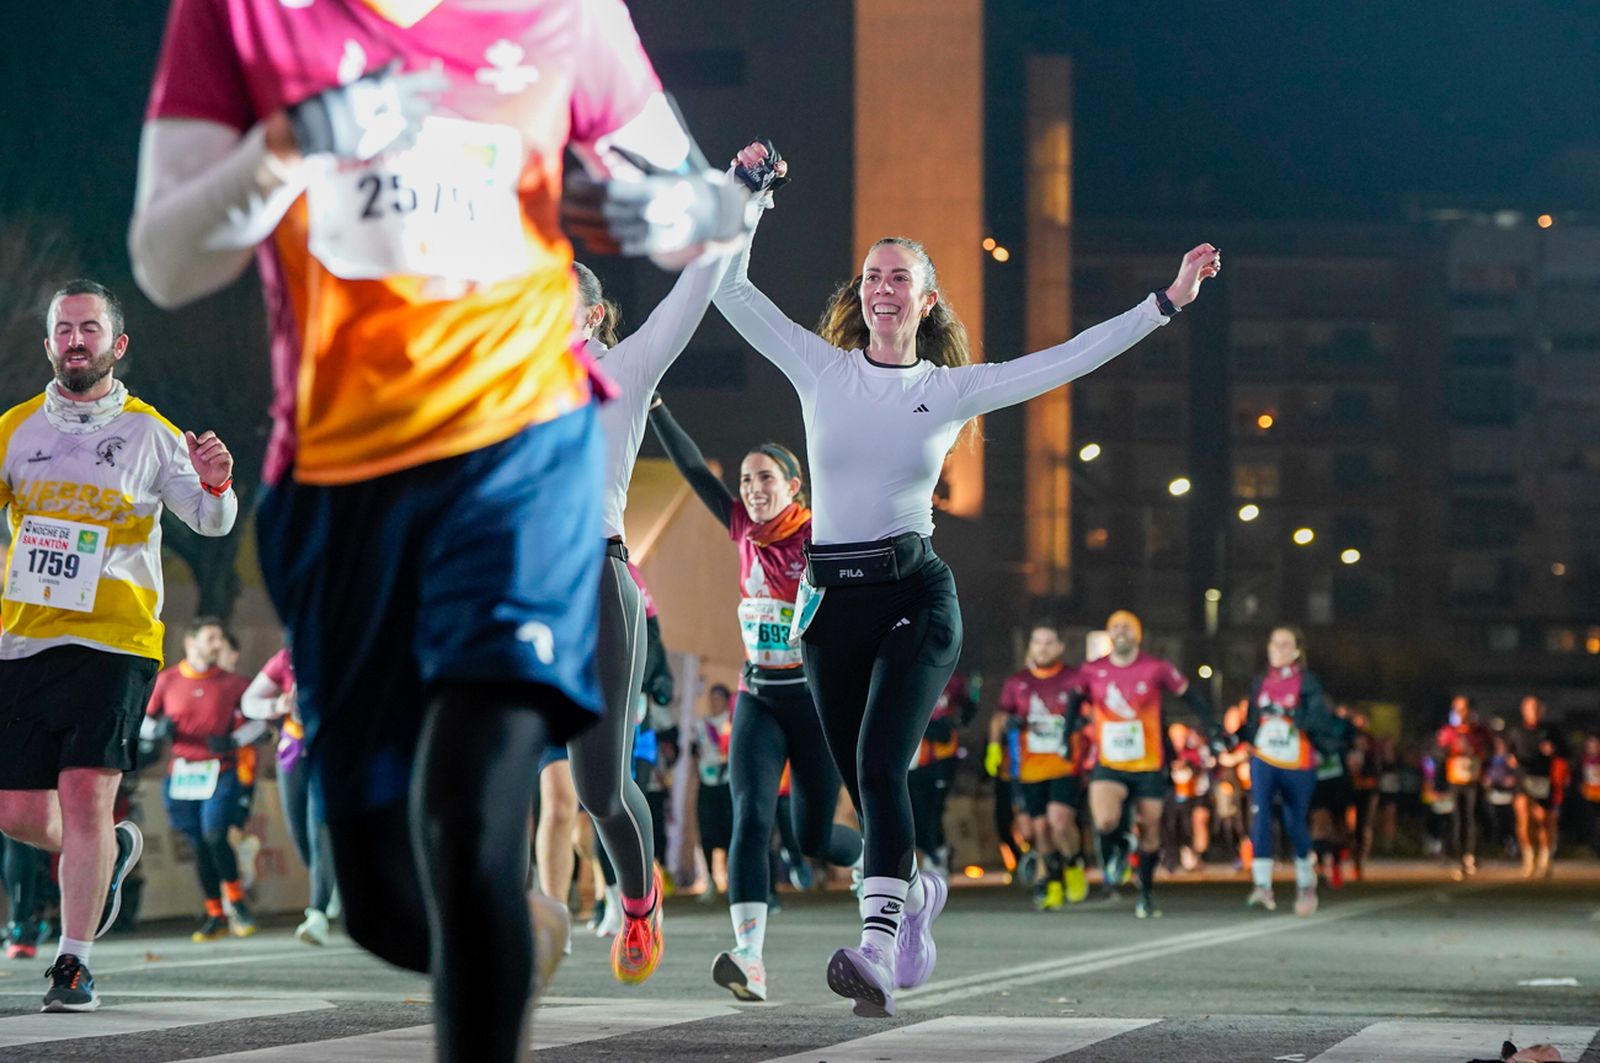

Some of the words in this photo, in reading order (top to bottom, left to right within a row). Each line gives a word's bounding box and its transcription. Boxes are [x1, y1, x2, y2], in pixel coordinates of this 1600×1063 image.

[32, 526, 58, 537] NOCHE
[59, 530, 70, 539] DE
[22, 535, 37, 545] SAN
[28, 548, 80, 579] 1759
[839, 568, 864, 578] FILA
